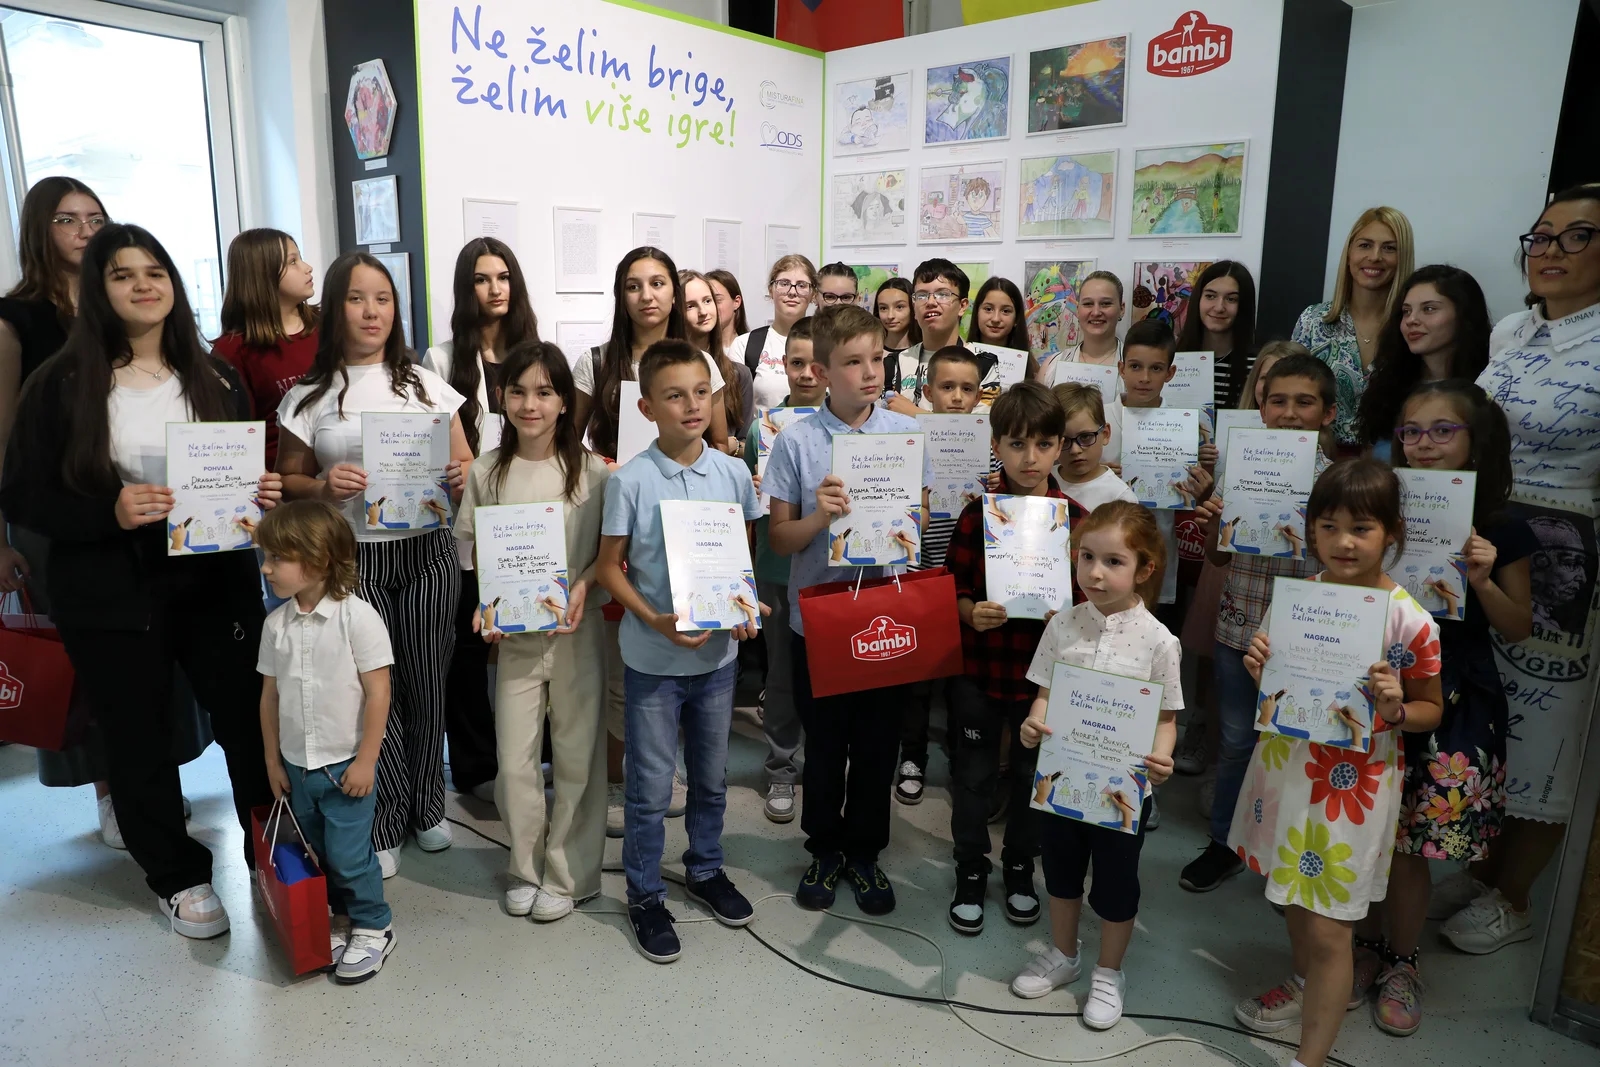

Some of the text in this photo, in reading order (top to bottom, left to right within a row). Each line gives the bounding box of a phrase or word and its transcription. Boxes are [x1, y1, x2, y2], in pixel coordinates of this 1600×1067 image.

[1153, 34, 1227, 67] bambi
[451, 5, 734, 113] Ne želim brige,
[1180, 65, 1195, 74] 1967
[451, 64, 736, 148] želim više igre!
[777, 131, 803, 147] ODS
[1564, 310, 1595, 325] DUNAV
[202, 442, 223, 450] želim
[226, 442, 247, 451] brige,
[1276, 448, 1297, 459] brige,
[864, 453, 883, 461] želim
[886, 453, 905, 462] brige,
[1424, 492, 1449, 503] brige,
[1429, 502, 1449, 510] igre!
[493, 524, 502, 532] Ne
[526, 521, 546, 530] brige,
[1291, 612, 1335, 626] želim više
[1292, 604, 1360, 623] Ne želim brige,
[857, 632, 911, 654] bambi
[1304, 633, 1340, 644] NAGRADA
[1070, 690, 1136, 713] Ne želim brige,
[1070, 699, 1136, 720] želim više igre!
[1081, 719, 1116, 732] NAGRADA
[1070, 728, 1099, 742] ANDREJA
[1100, 754, 1122, 763] MESTO
[1539, 774, 1555, 804] Beograd
